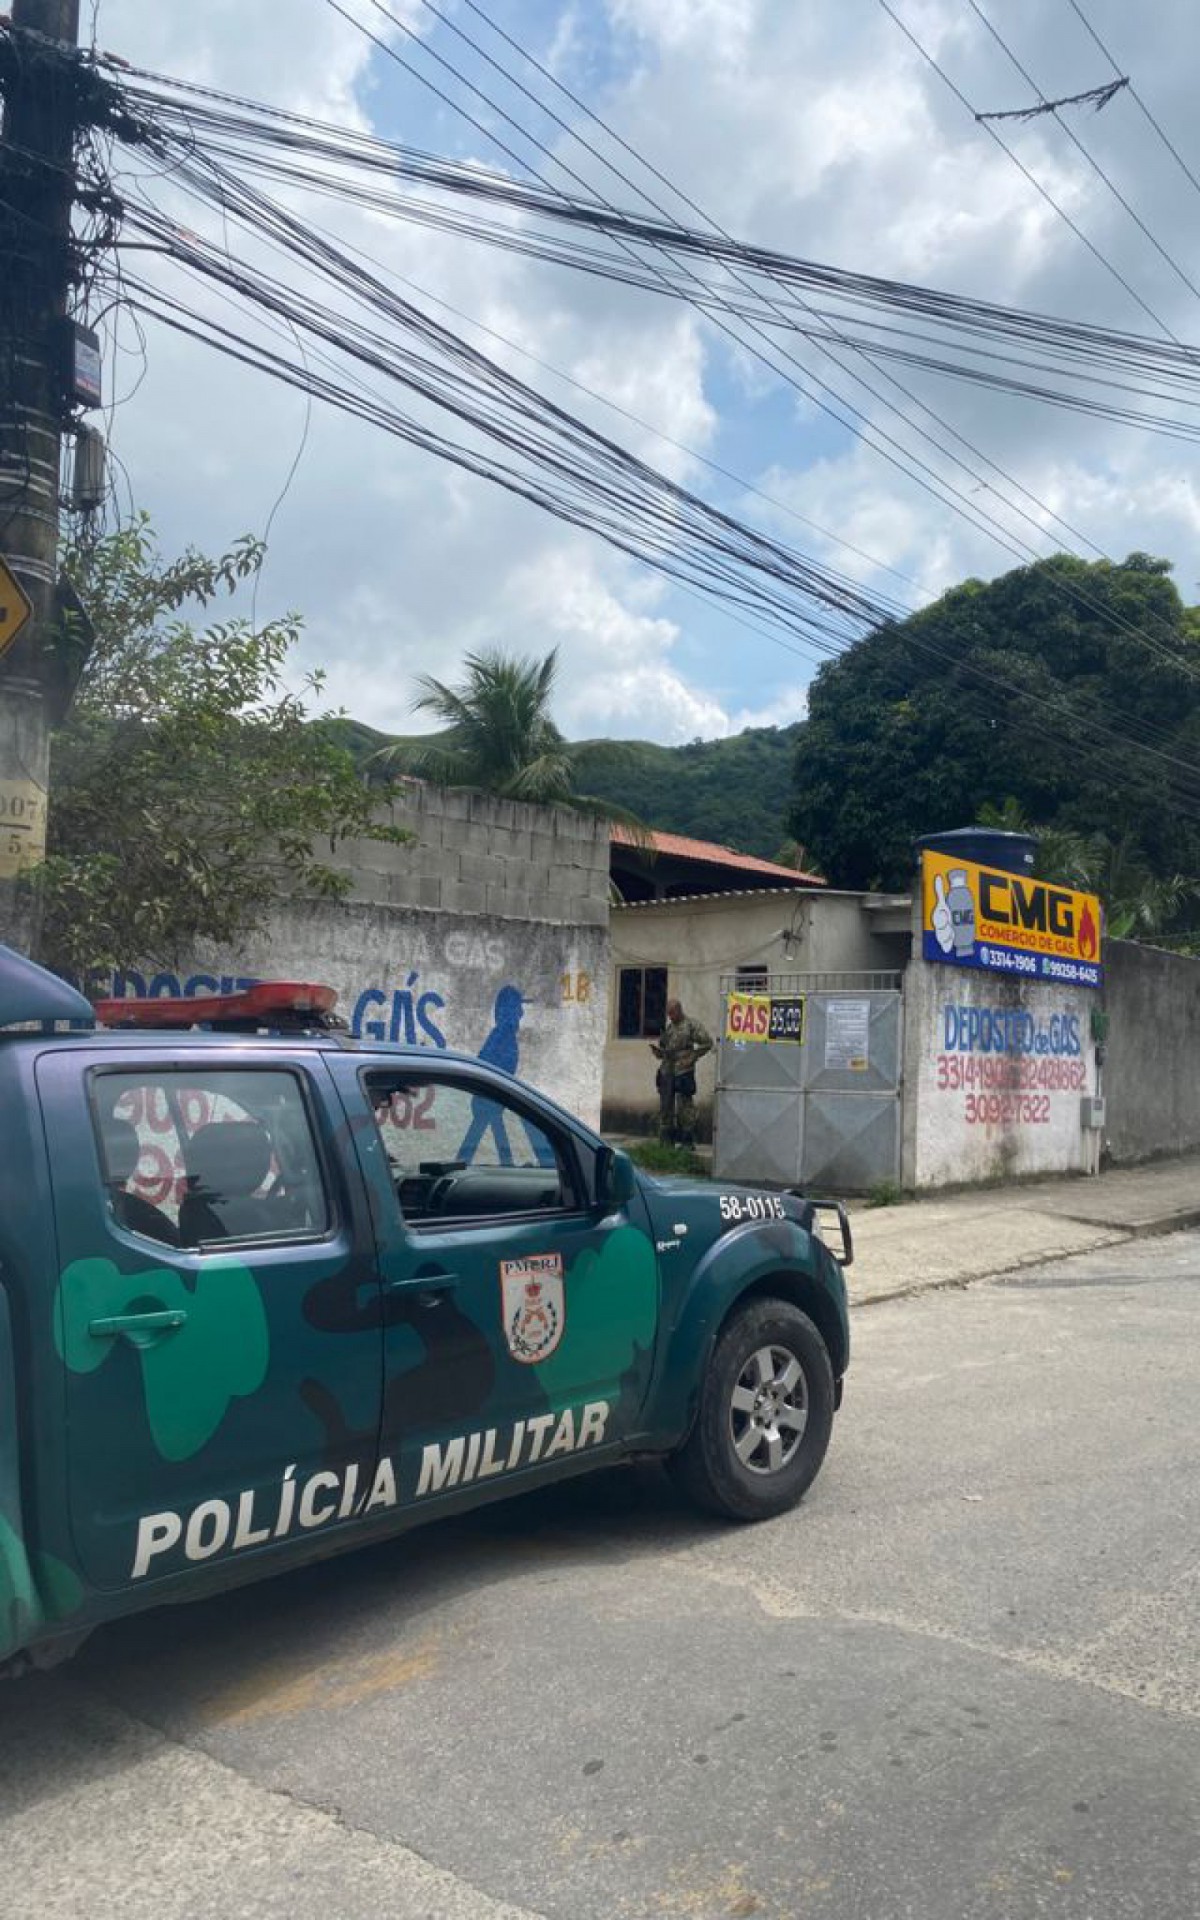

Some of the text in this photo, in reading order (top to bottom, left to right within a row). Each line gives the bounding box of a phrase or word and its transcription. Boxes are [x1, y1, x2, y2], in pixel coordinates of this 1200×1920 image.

[979, 871, 1073, 938] CMG
[980, 923, 1037, 947] COMERCIO
[1039, 936, 1054, 950] DE
[352, 970, 447, 1049] GÁS
[730, 1004, 767, 1034] GAS
[719, 1196, 786, 1220] 58-0115
[131, 1400, 611, 1578] POLÍCIA MILITAR
